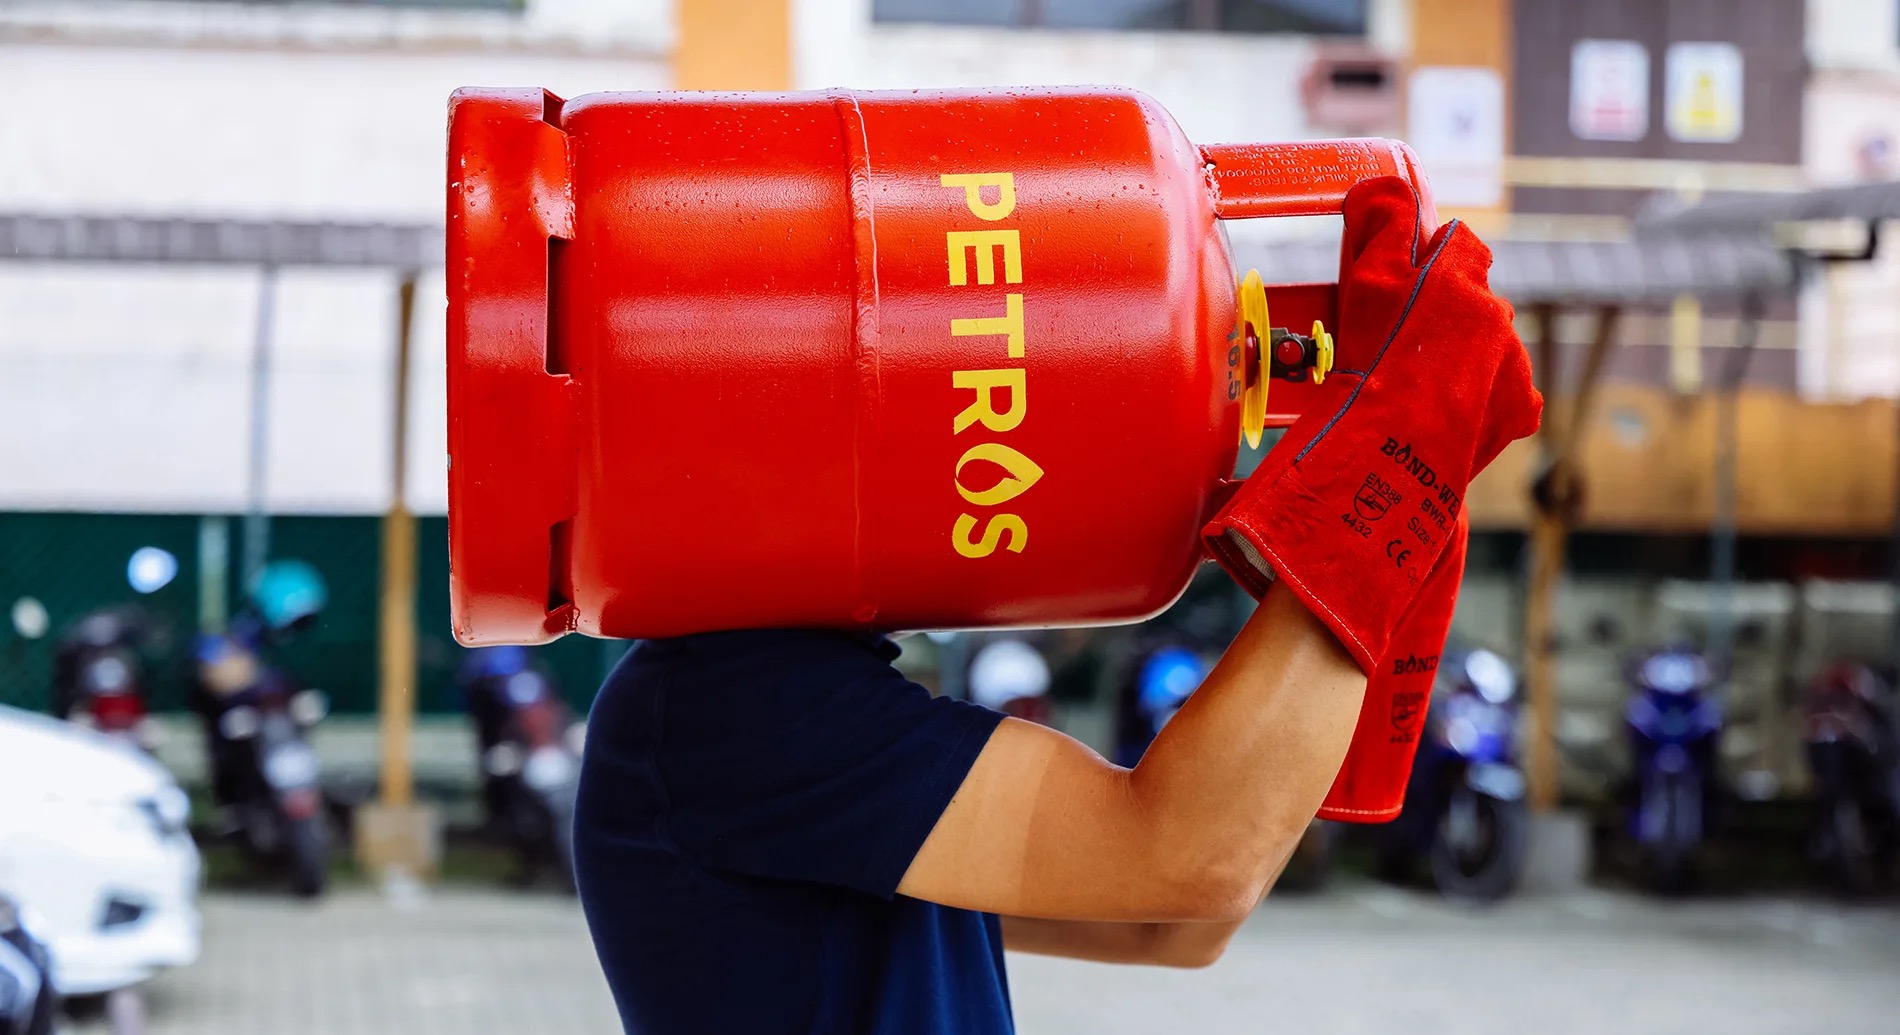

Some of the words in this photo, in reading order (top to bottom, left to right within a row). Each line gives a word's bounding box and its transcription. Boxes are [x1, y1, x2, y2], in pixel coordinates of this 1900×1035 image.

[1313, 173, 1349, 184] MILIK
[940, 172, 1045, 559] PETROS
[1227, 323, 1241, 401] 16.5
[1365, 472, 1402, 505] EN388
[1341, 513, 1373, 539] 4432
